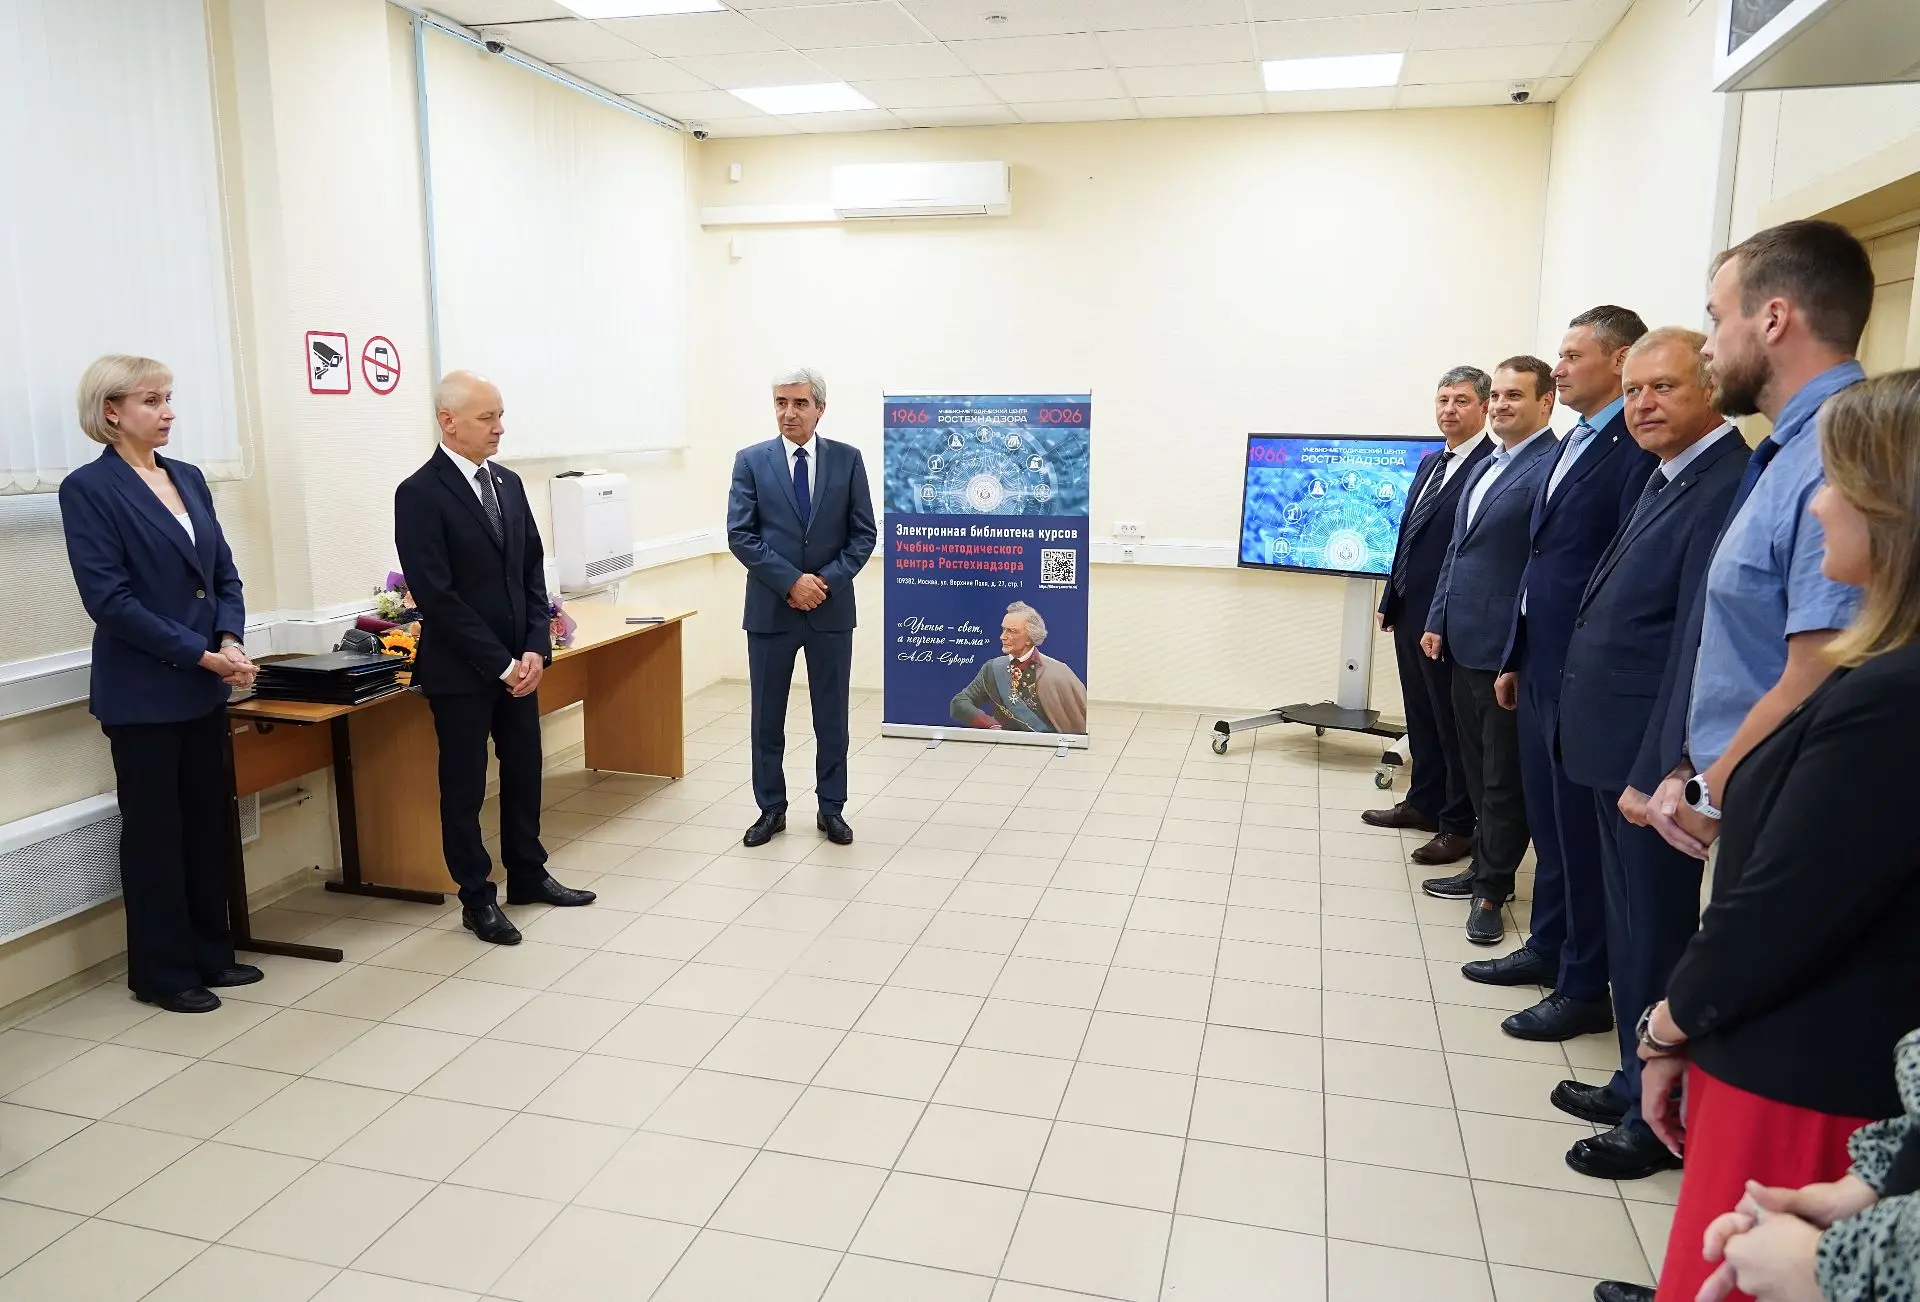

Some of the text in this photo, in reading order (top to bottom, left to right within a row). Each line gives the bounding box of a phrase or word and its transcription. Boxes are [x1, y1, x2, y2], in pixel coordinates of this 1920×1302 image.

[891, 409, 929, 423] 1966
[938, 415, 1028, 424] РОСТЕХНАДЗОРА
[1039, 408, 1082, 423] 2026
[1249, 445, 1287, 463] 1966
[1301, 454, 1406, 466] РОСТЕХНАДЗОРА
[896, 523, 1078, 541] Электронная библиотека курсов
[896, 540, 1024, 555] Учебно-методического
[896, 557, 1024, 574] центра Ростехнадзора
[957, 620, 983, 634] свет,
[897, 635, 904, 643] а
[906, 635, 946, 647] неученье
[936, 651, 975, 666] Суворов
